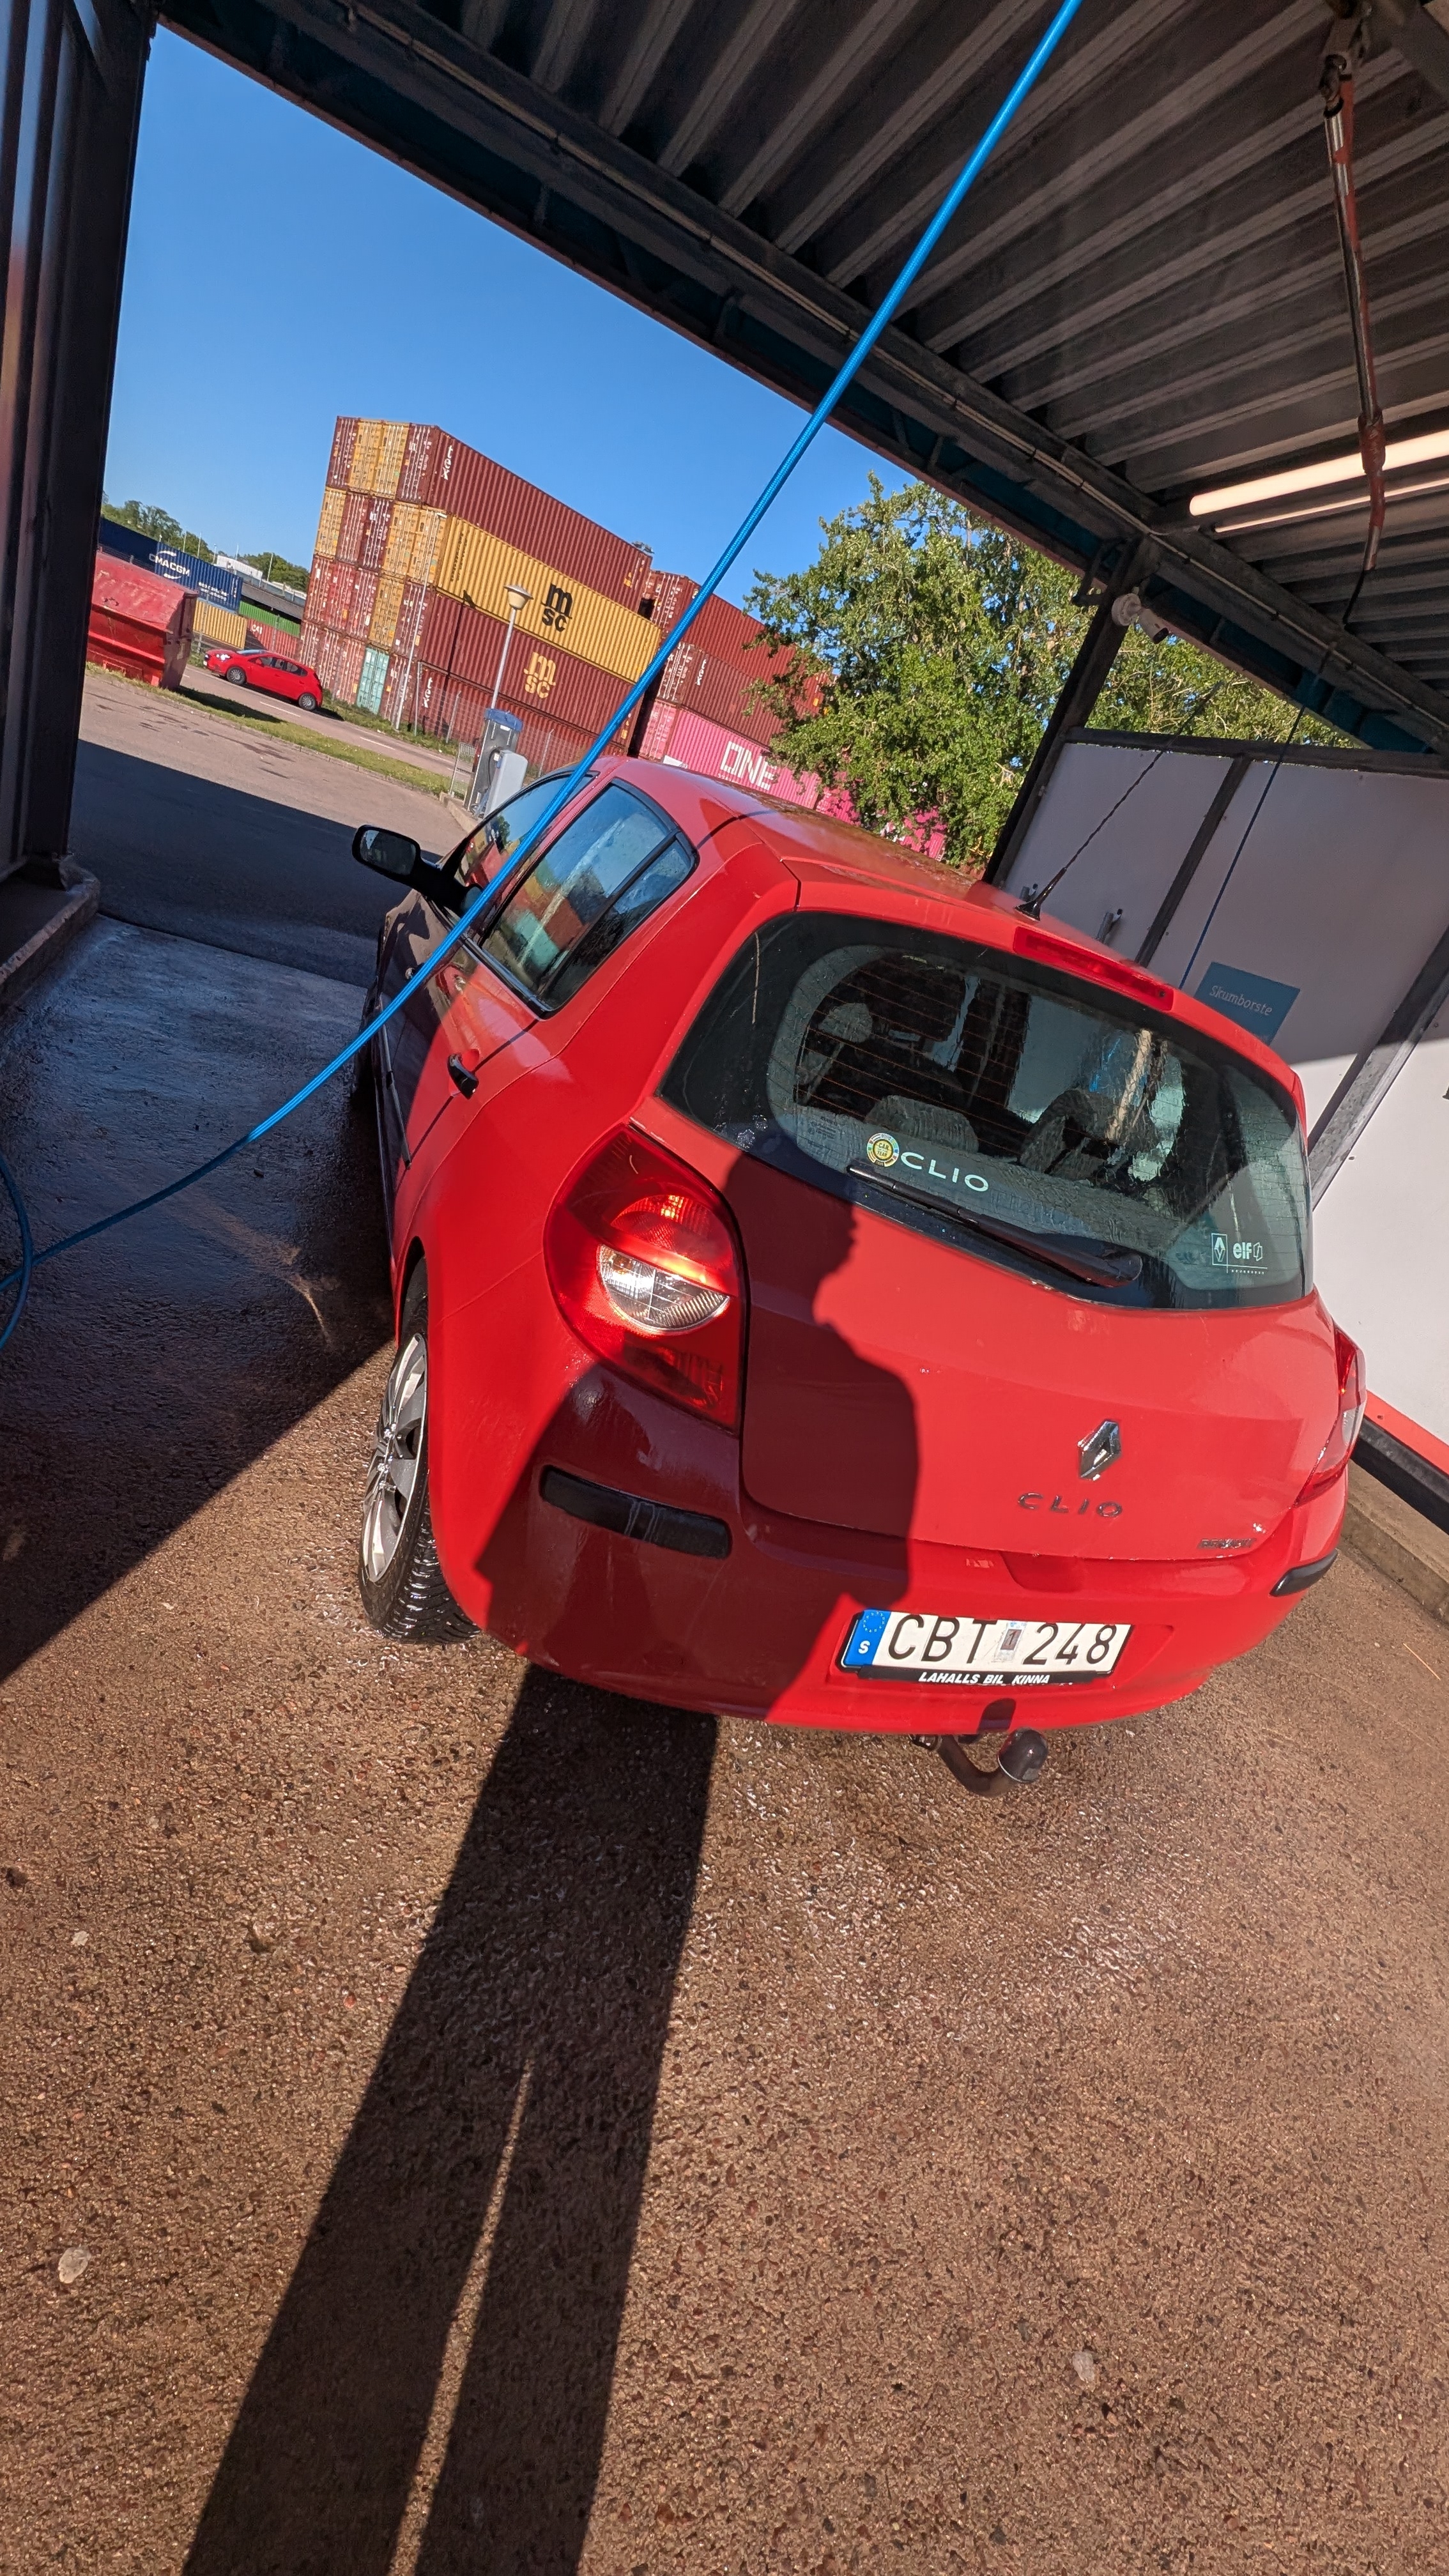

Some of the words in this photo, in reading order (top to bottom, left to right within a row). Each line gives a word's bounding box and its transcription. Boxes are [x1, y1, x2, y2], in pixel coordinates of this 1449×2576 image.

[719, 741, 777, 790] ONE
[1209, 985, 1273, 1015] Skumborste
[900, 1152, 988, 1192] CLIO
[1233, 1242, 1252, 1259] elf
[1017, 1492, 1123, 1517] CLIO
[859, 1640, 870, 1654] S
[888, 1614, 997, 1664] CBT
[1023, 1623, 1117, 1665] 248
[918, 1671, 980, 1684] LAHALLS
[983, 1674, 1004, 1684] BIL
[1011, 1675, 1050, 1684] KINNA
